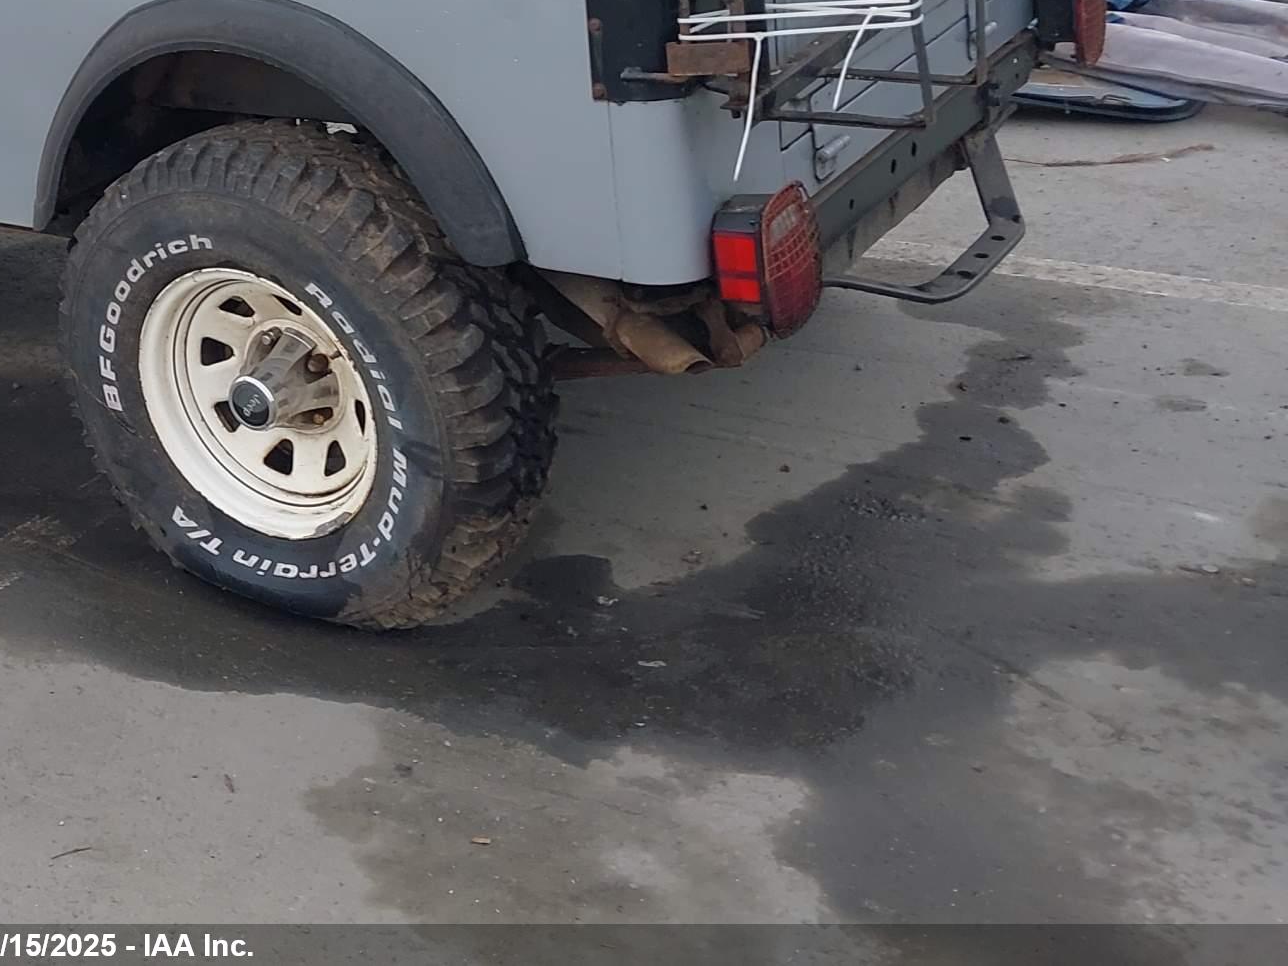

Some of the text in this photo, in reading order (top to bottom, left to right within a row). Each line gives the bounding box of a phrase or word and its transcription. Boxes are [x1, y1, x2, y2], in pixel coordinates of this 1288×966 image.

[98, 233, 214, 412] BFGoodrich
[171, 281, 411, 580] Radial Mud-Terrain T/A
